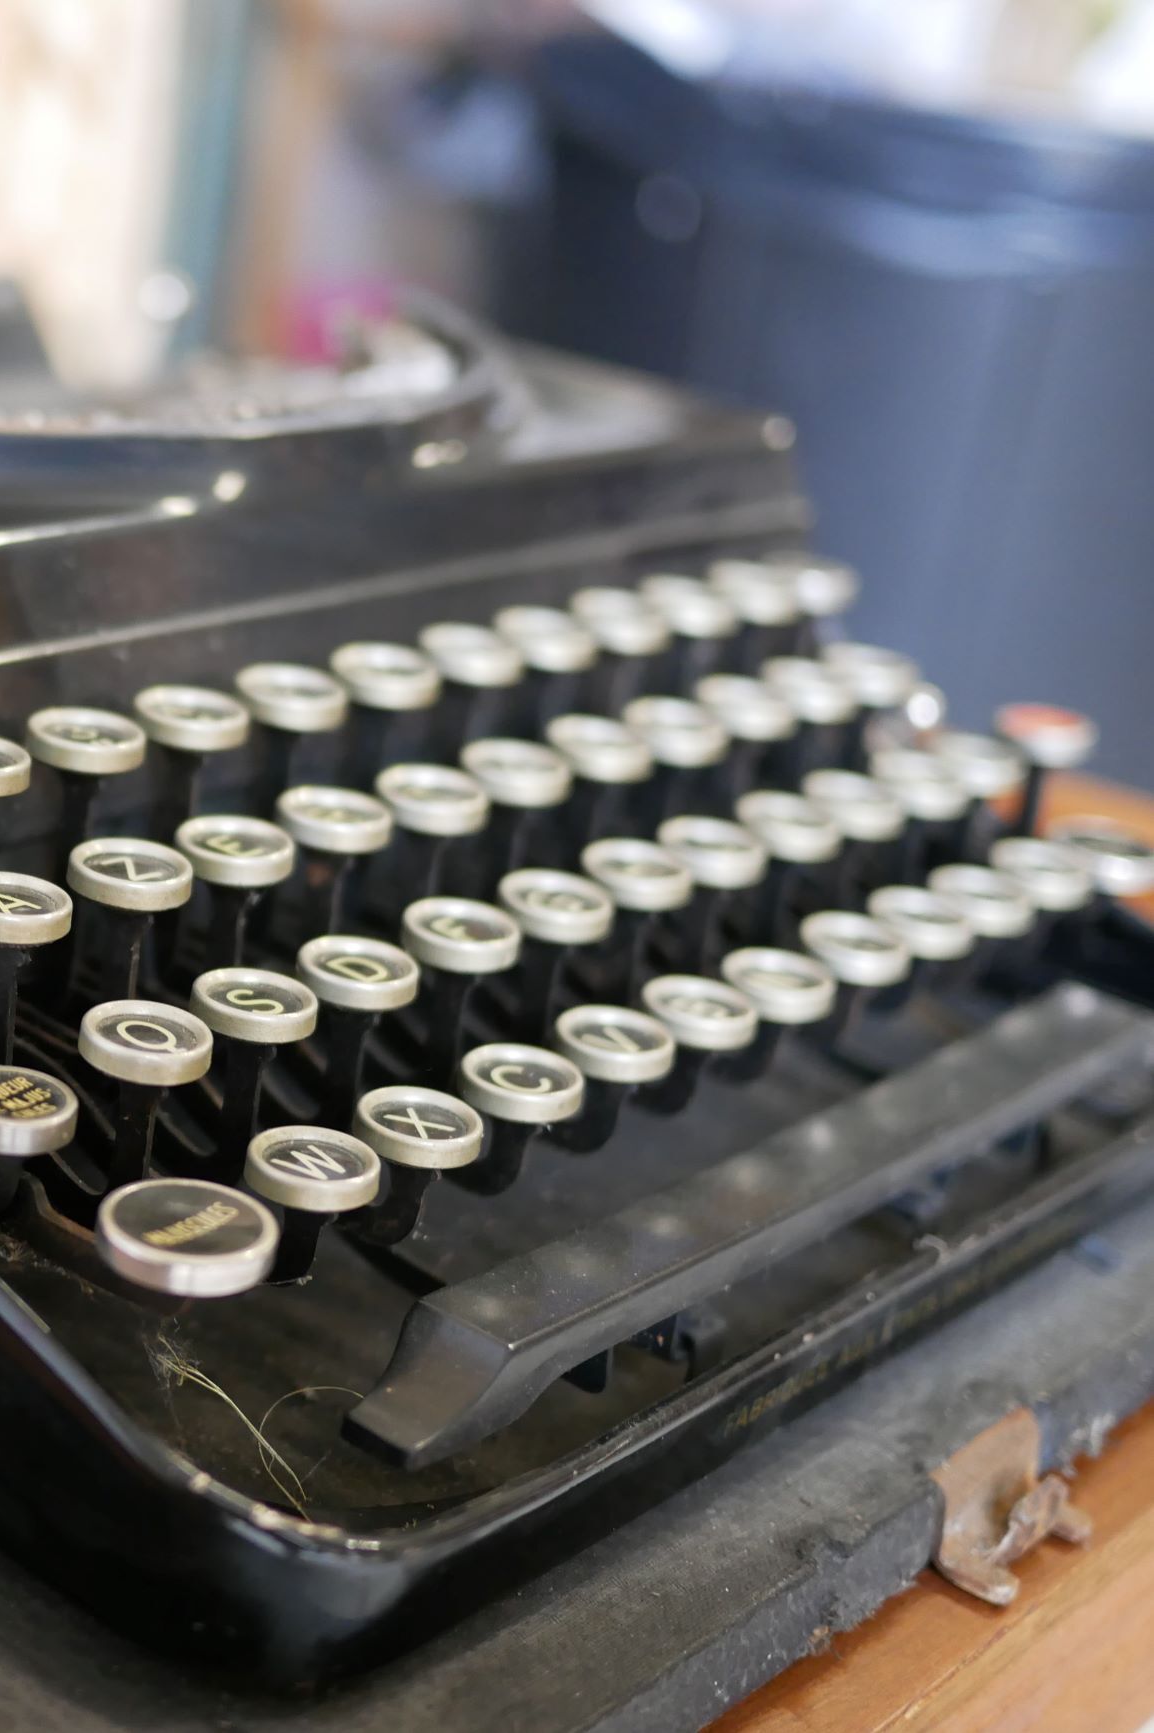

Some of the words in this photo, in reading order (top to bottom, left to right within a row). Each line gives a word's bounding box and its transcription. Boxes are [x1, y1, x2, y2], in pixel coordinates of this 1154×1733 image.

[207, 834, 267, 858] E
[102, 857, 162, 882] Z
[326, 956, 389, 983] D
[226, 989, 284, 1015] S
[115, 1020, 187, 1053] Q
[580, 1026, 642, 1053] V
[490, 1064, 552, 1093] C
[383, 1106, 456, 1139] X
[269, 1144, 347, 1181] W
